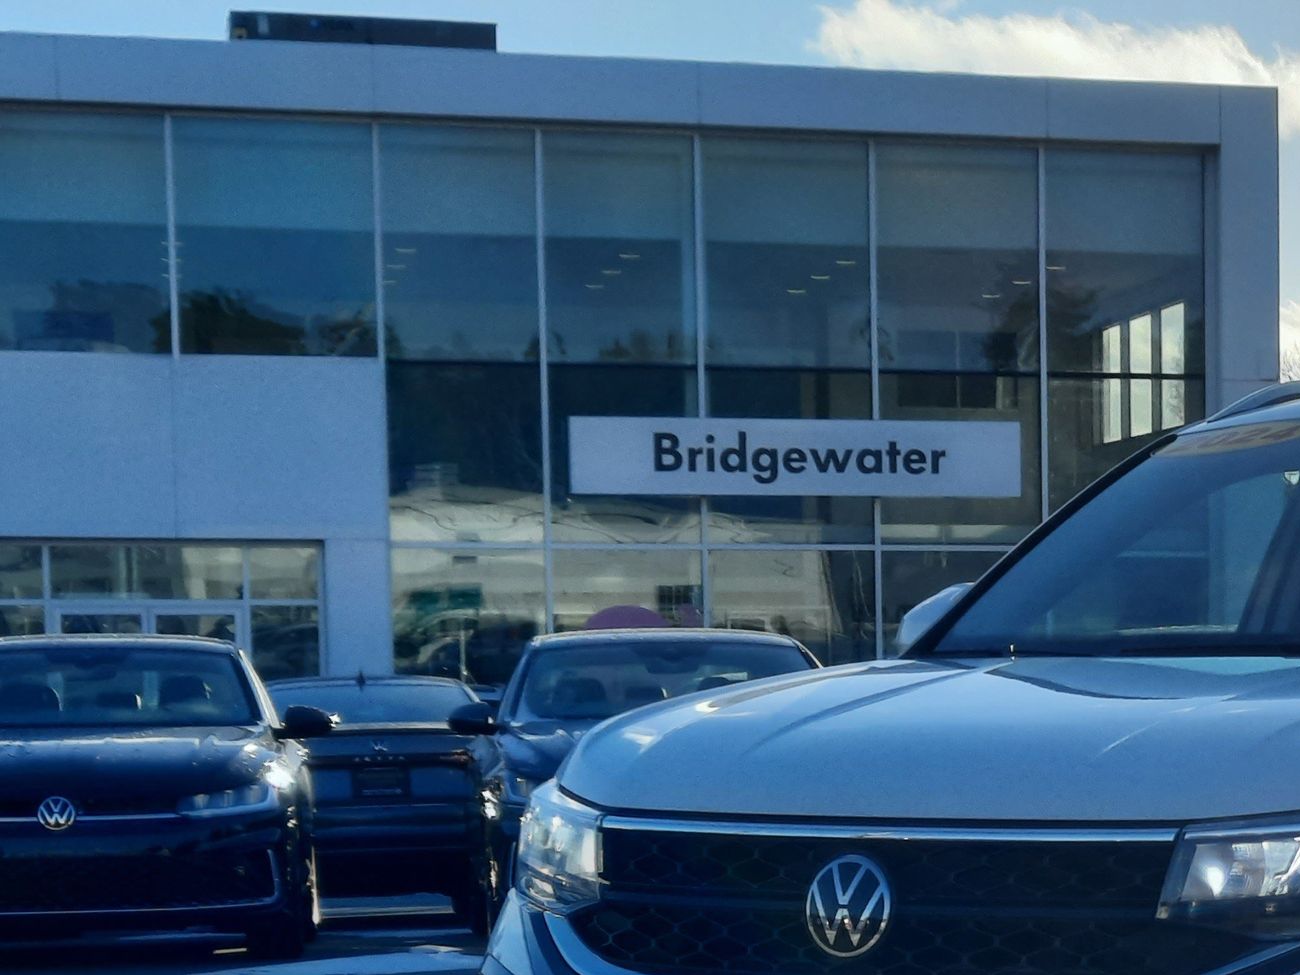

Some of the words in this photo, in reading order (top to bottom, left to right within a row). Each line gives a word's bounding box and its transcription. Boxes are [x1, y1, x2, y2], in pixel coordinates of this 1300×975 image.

[652, 431, 947, 484] Bridgewater
[37, 796, 75, 830] VW
[806, 854, 890, 957] VW
